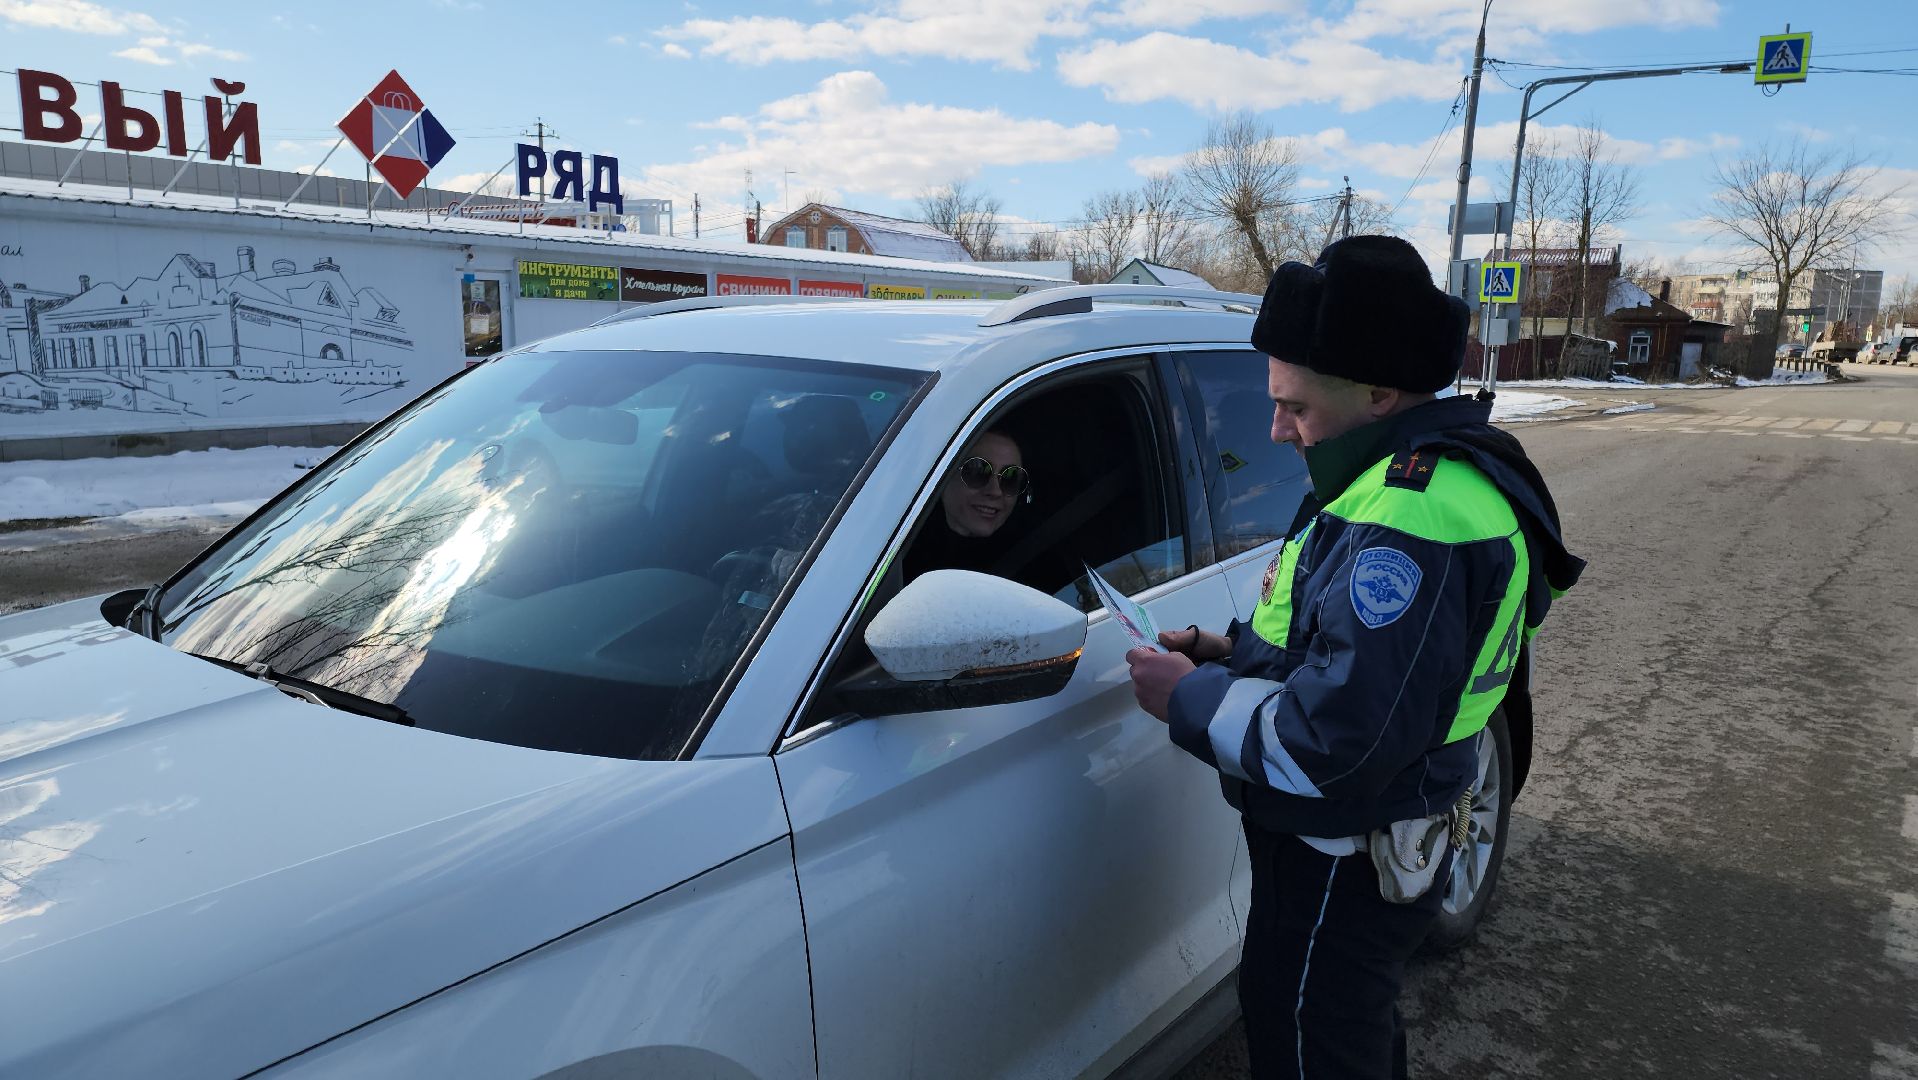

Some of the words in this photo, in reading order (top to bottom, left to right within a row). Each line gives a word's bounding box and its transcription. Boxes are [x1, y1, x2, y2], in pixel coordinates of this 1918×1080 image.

[16, 68, 262, 165] ВЫЙ
[515, 143, 624, 214] РЯД
[518, 261, 619, 280] ИНСТРУМЕНТЫ
[550, 278, 565, 287] для
[568, 279, 590, 288] дома
[719, 283, 788, 296] СВИНИНА
[563, 290, 587, 299] дачи
[1364, 552, 1418, 580] ПОЛИЦИЯ
[1366, 564, 1409, 586] РОССИЯ
